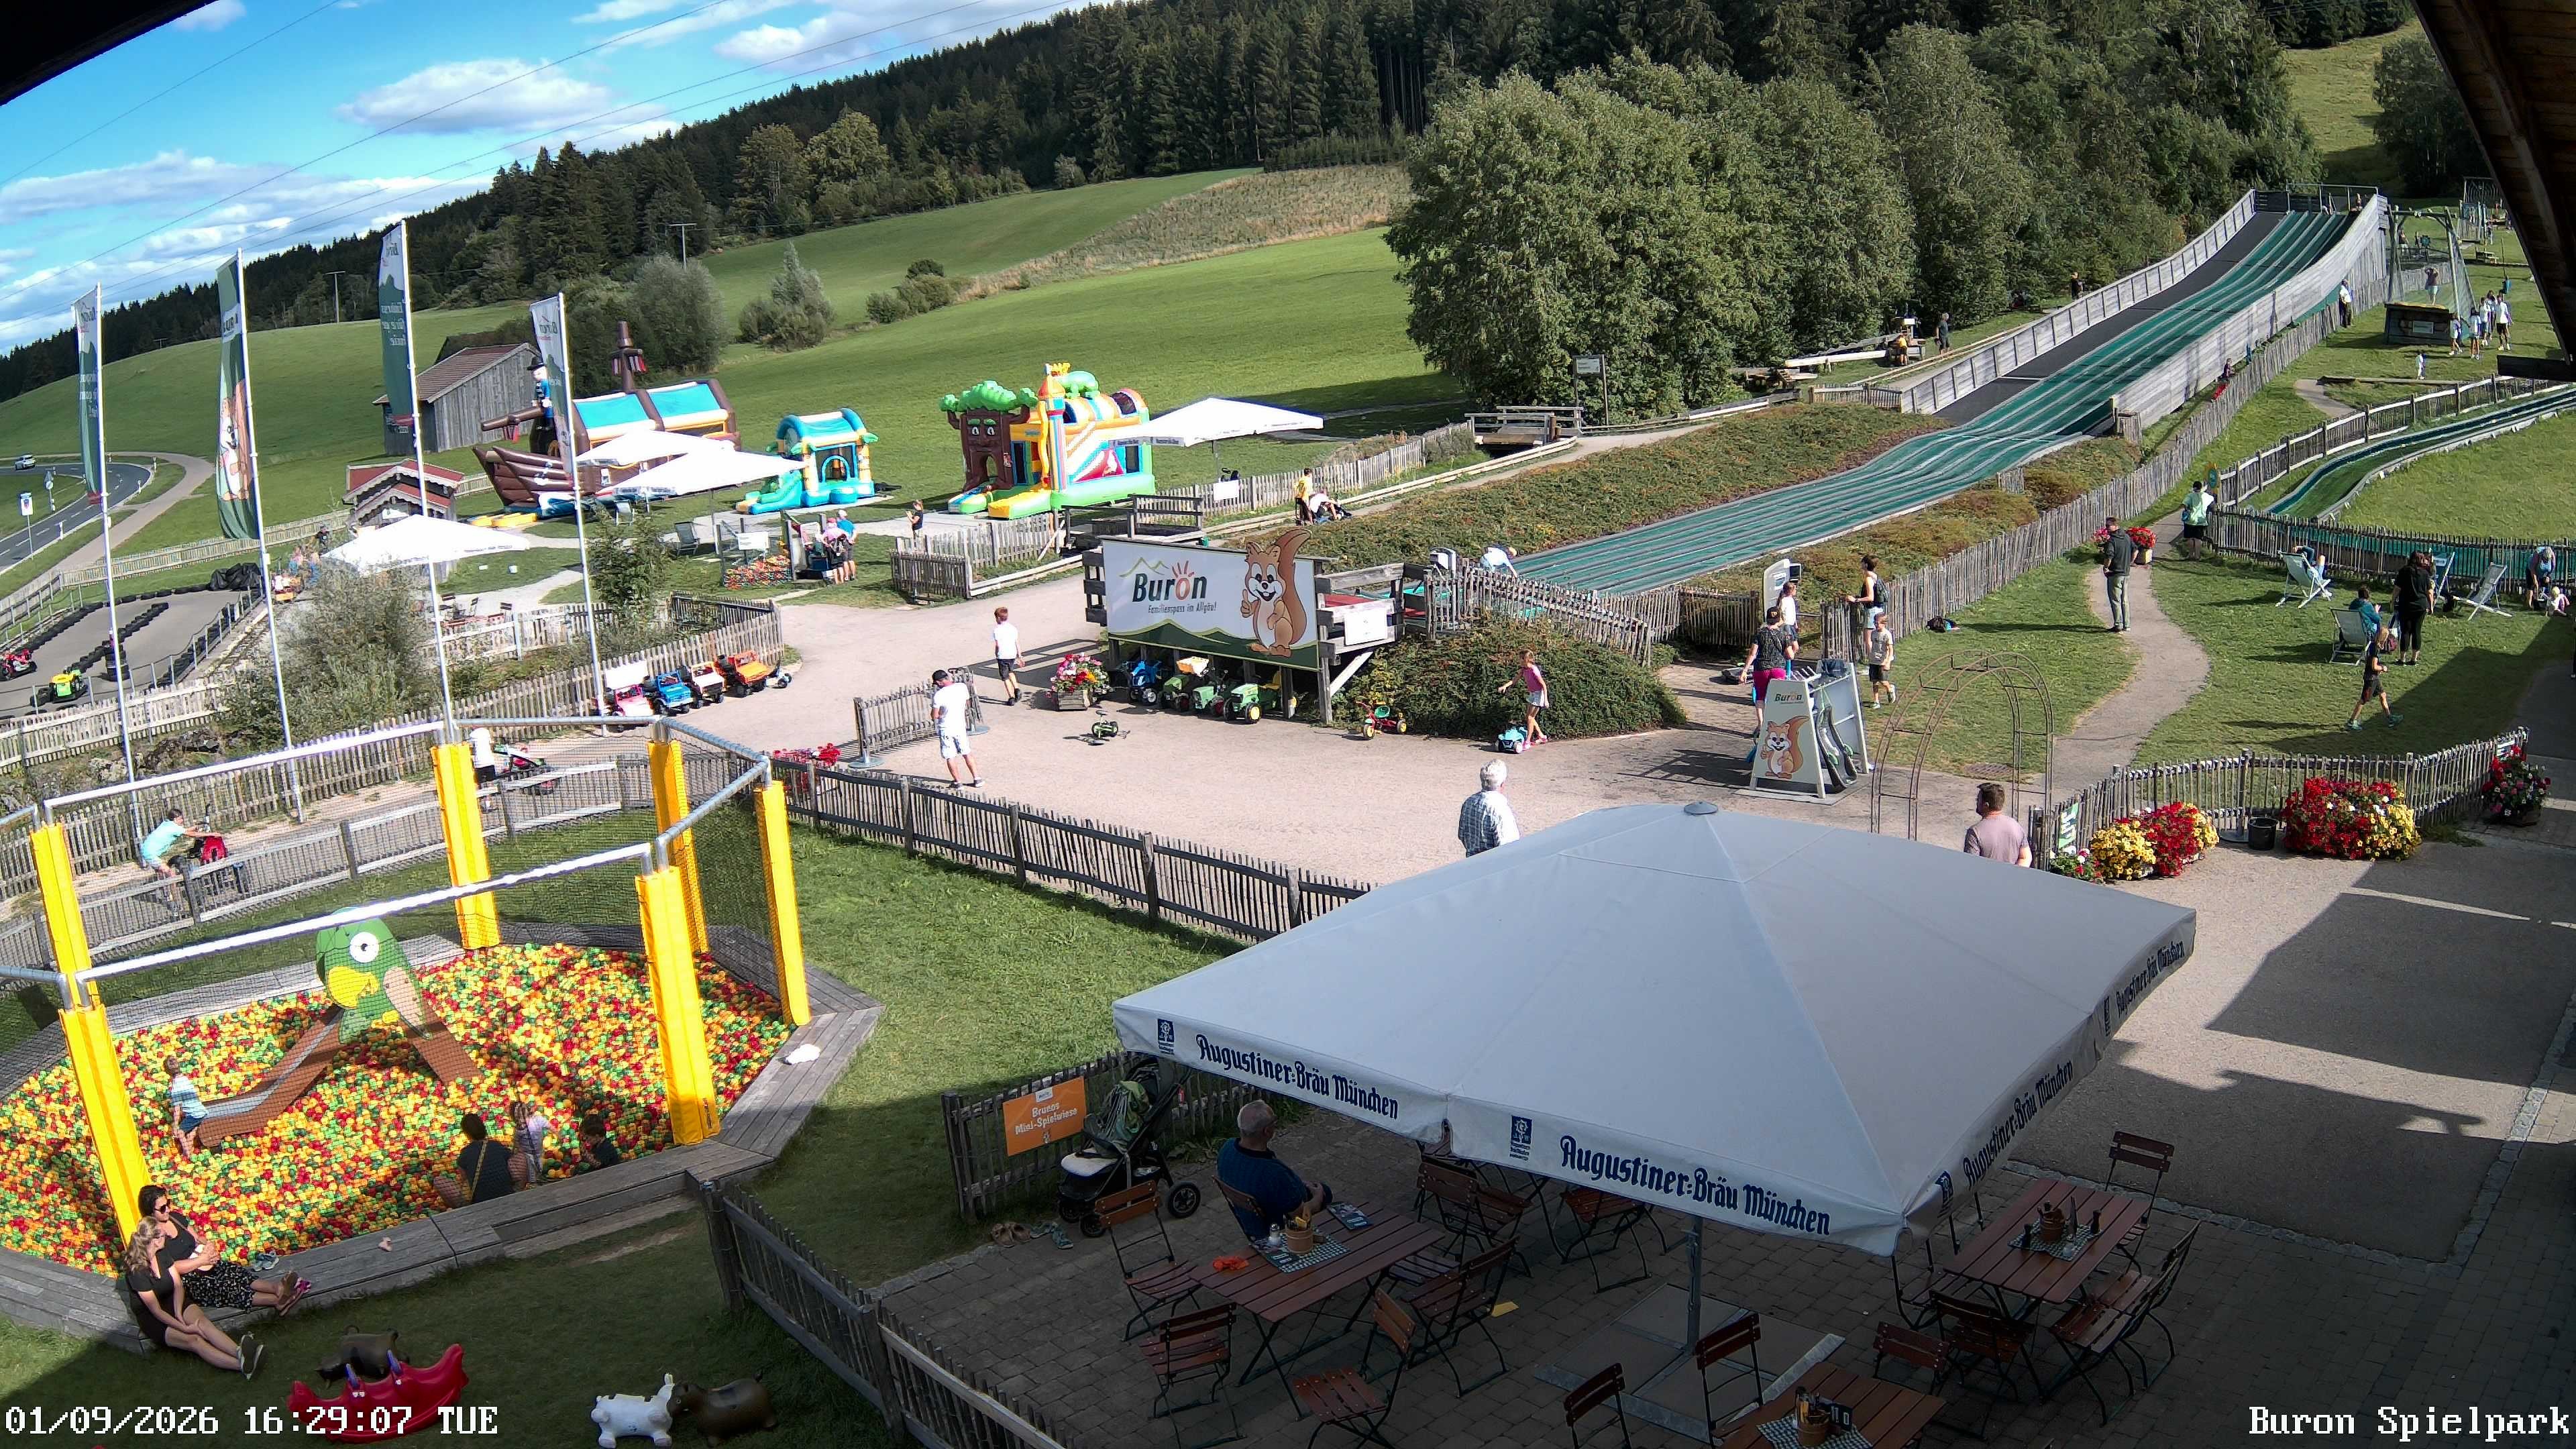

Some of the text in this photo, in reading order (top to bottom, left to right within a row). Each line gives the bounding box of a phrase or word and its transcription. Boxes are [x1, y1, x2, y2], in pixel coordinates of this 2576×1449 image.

[1132, 572, 1208, 602] Buron
[1331, 1074, 1399, 1120] München
[2035, 1060, 2073, 1108] München
[1742, 1184, 1830, 1236] München
